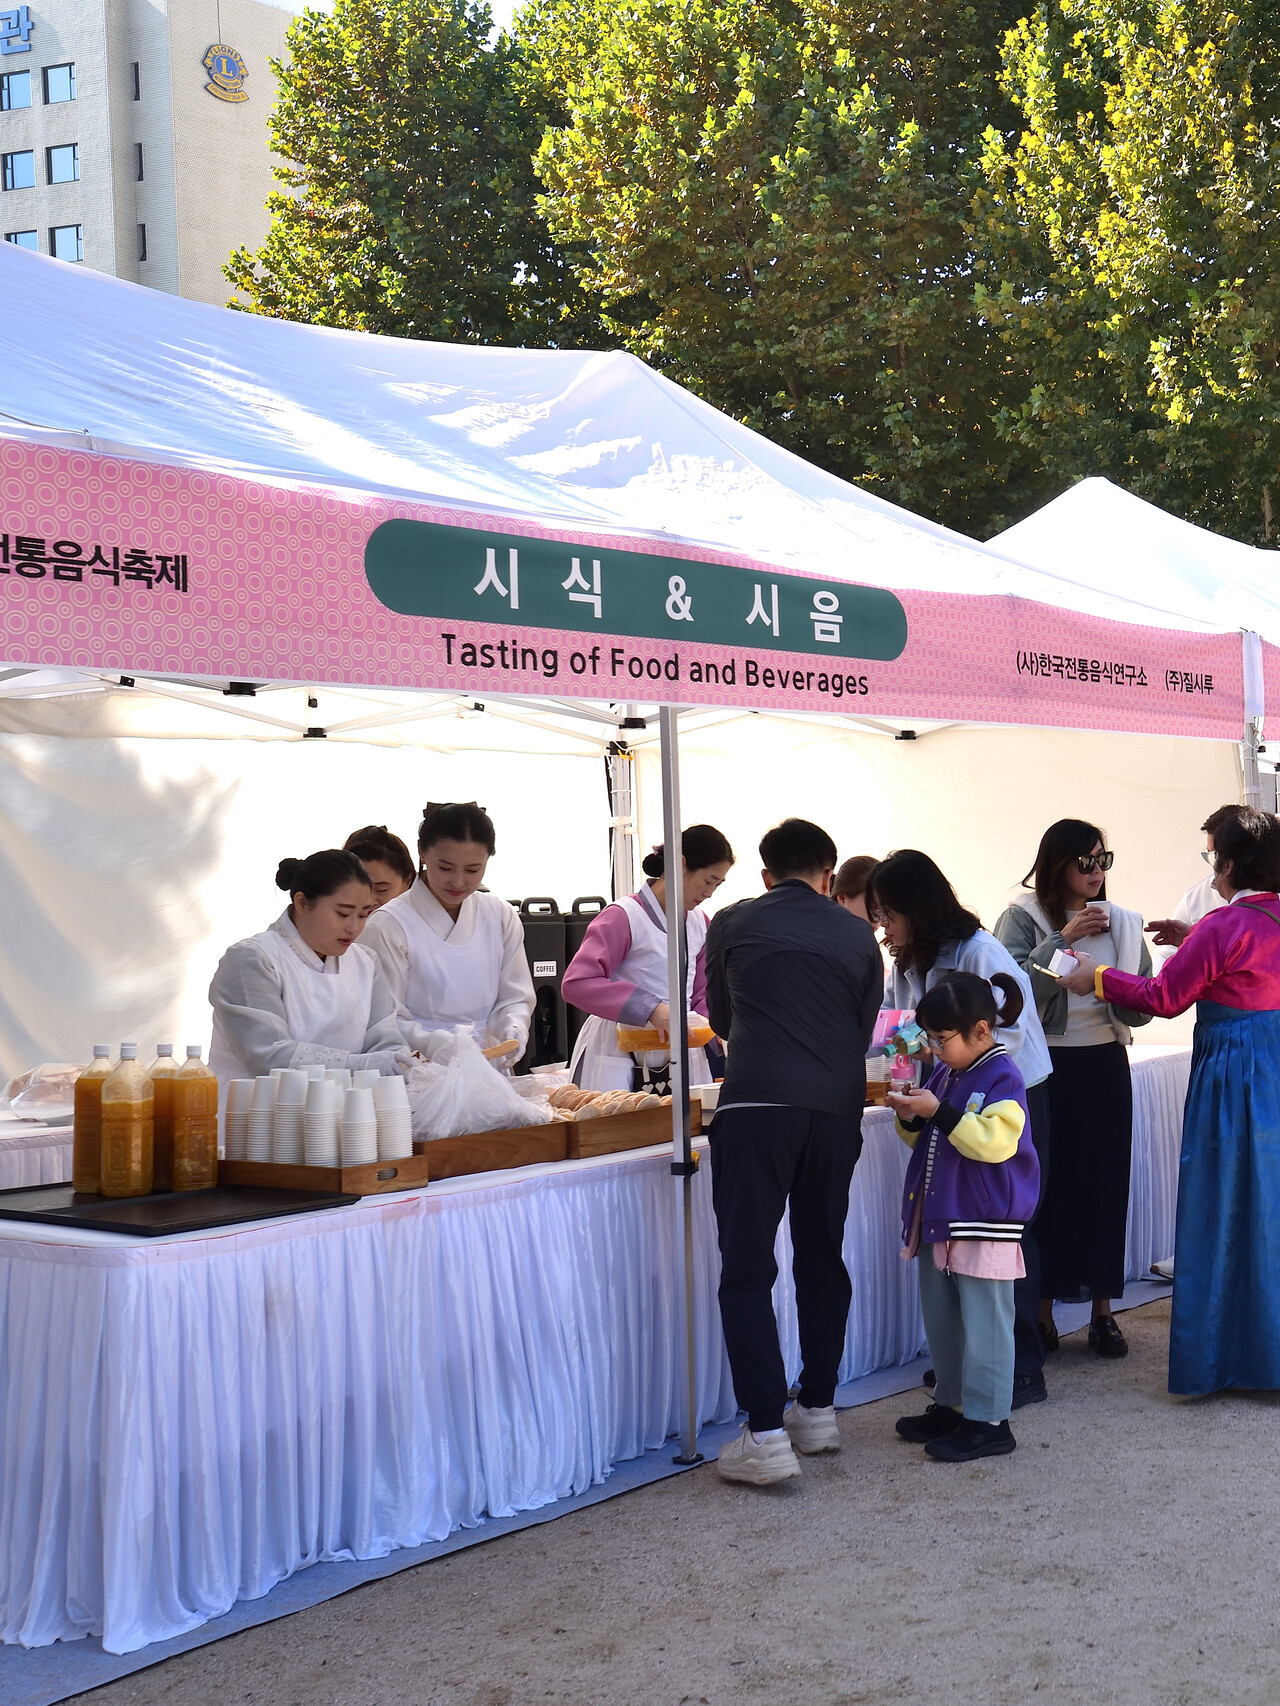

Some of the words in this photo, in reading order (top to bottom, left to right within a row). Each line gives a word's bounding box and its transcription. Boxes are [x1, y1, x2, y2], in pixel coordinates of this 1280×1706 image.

[213, 46, 240, 59] LIONS
[220, 57, 234, 77] L
[665, 575, 695, 622] &
[441, 633, 559, 678] Tasting
[571, 646, 601, 676] of
[610, 648, 680, 682] Food
[689, 657, 736, 686] and
[745, 660, 869, 697] Beverages
[1016, 650, 1149, 687] (사)한국전통음식연구소
[1165, 669, 1214, 696] (주)질시루
